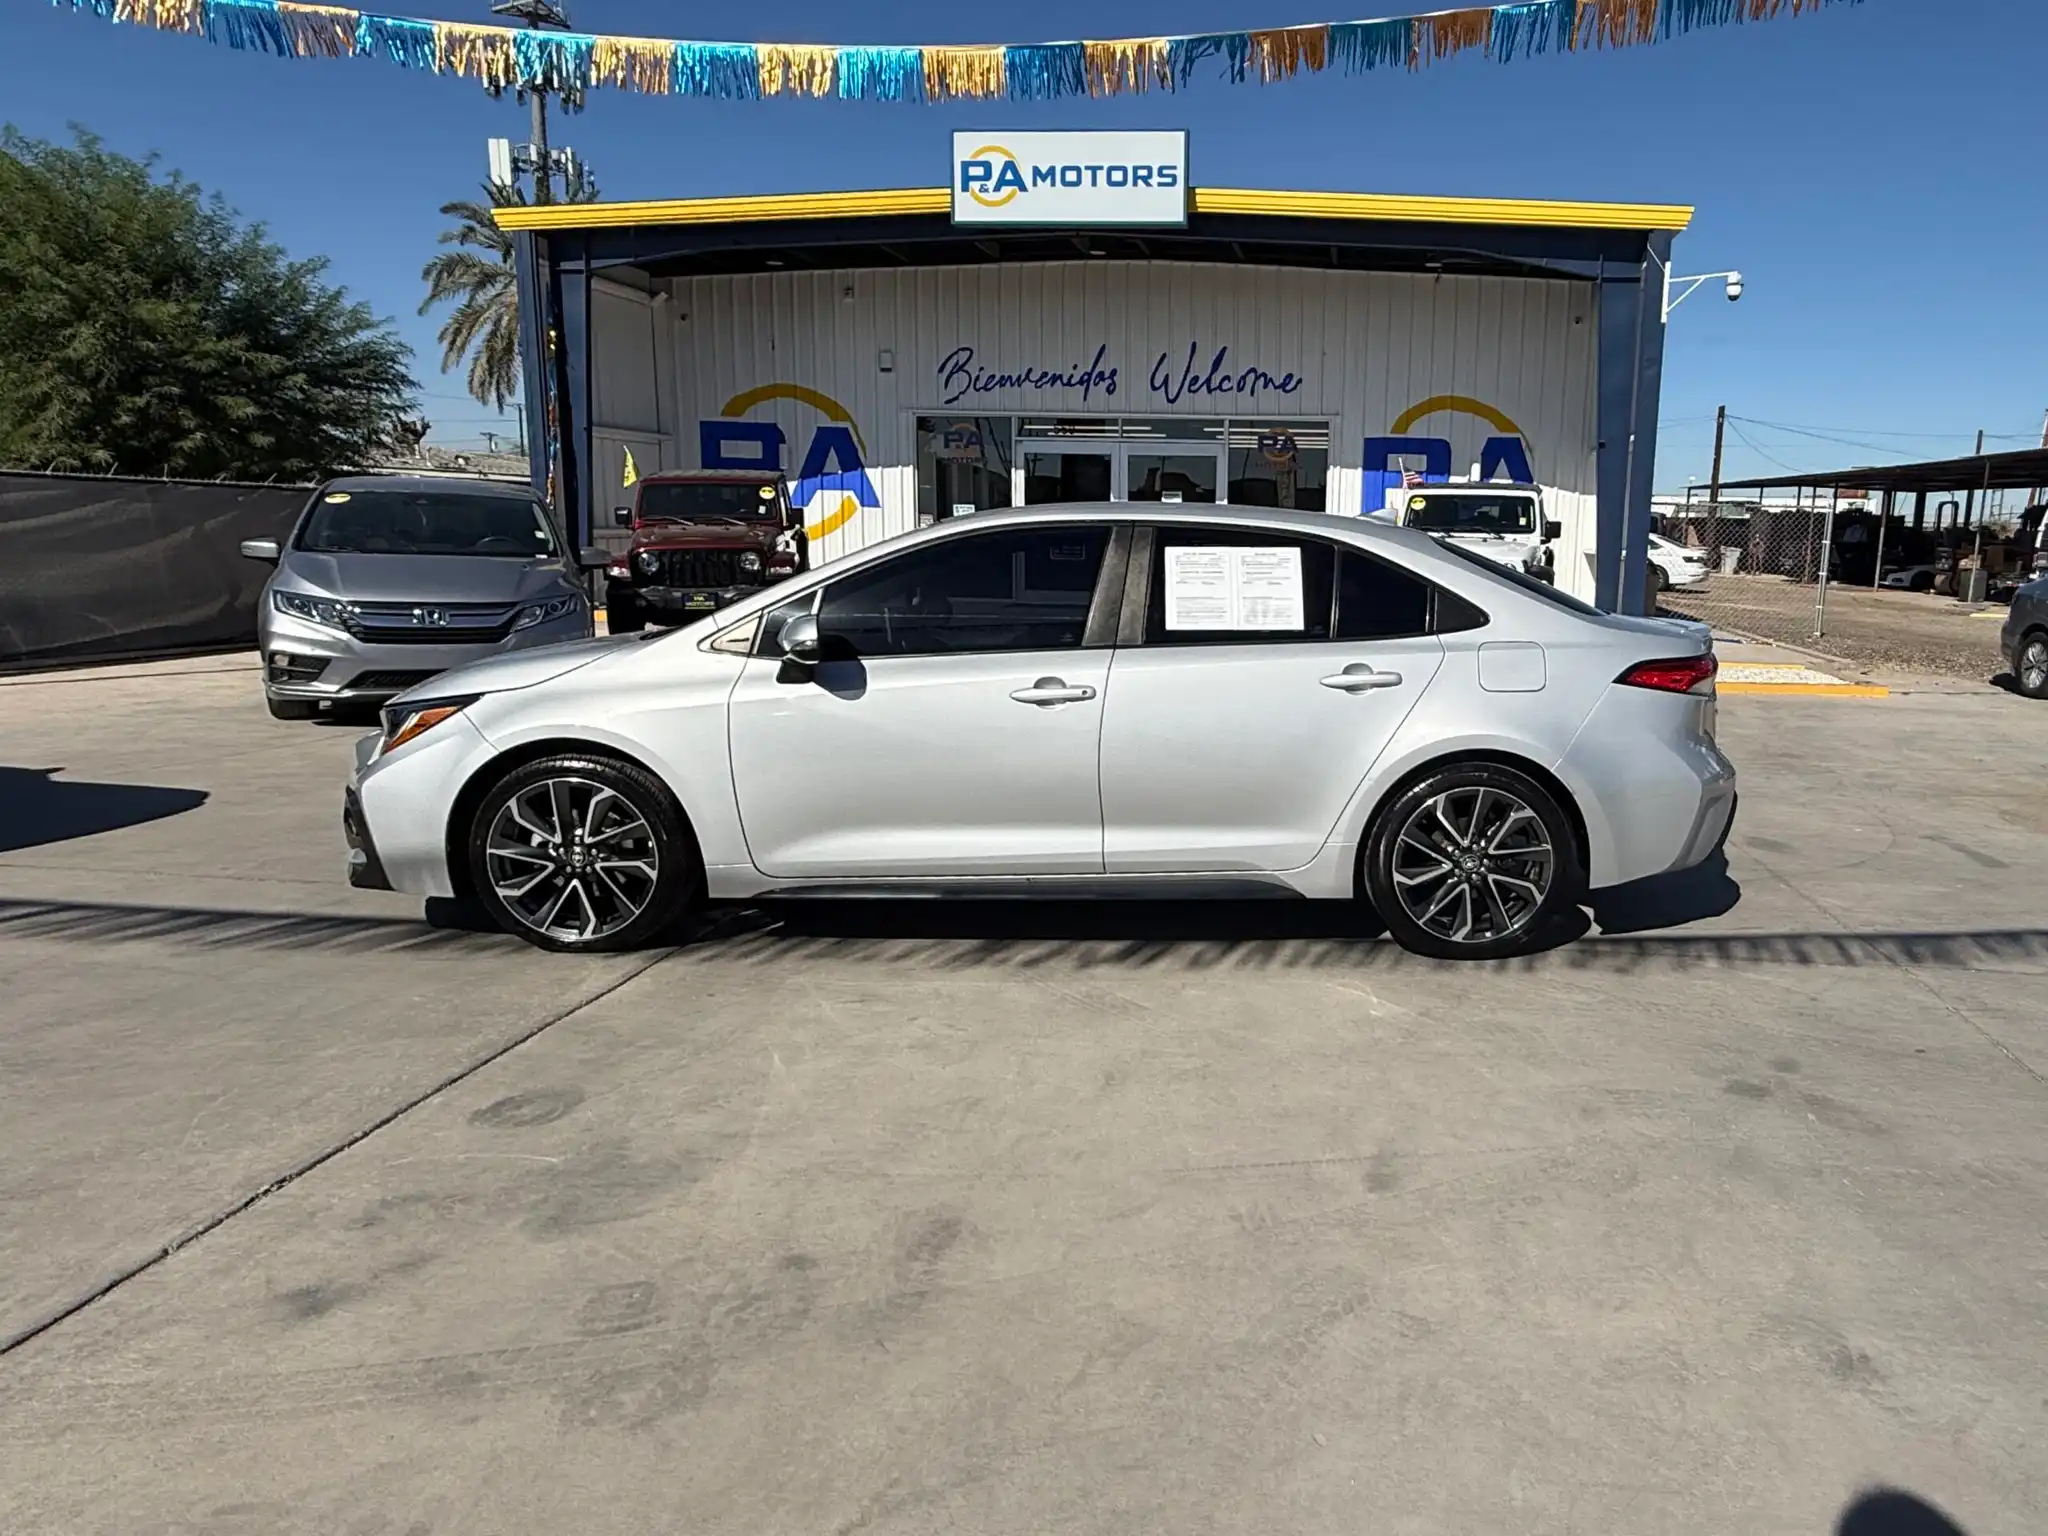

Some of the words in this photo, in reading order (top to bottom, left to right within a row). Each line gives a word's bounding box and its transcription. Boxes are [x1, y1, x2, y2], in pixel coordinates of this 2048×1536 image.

[960, 160, 1029, 193] P&A
[1032, 165, 1178, 187] MOTORS
[938, 344, 1118, 404] Bienvenidos
[1150, 341, 1302, 404] Welcome
